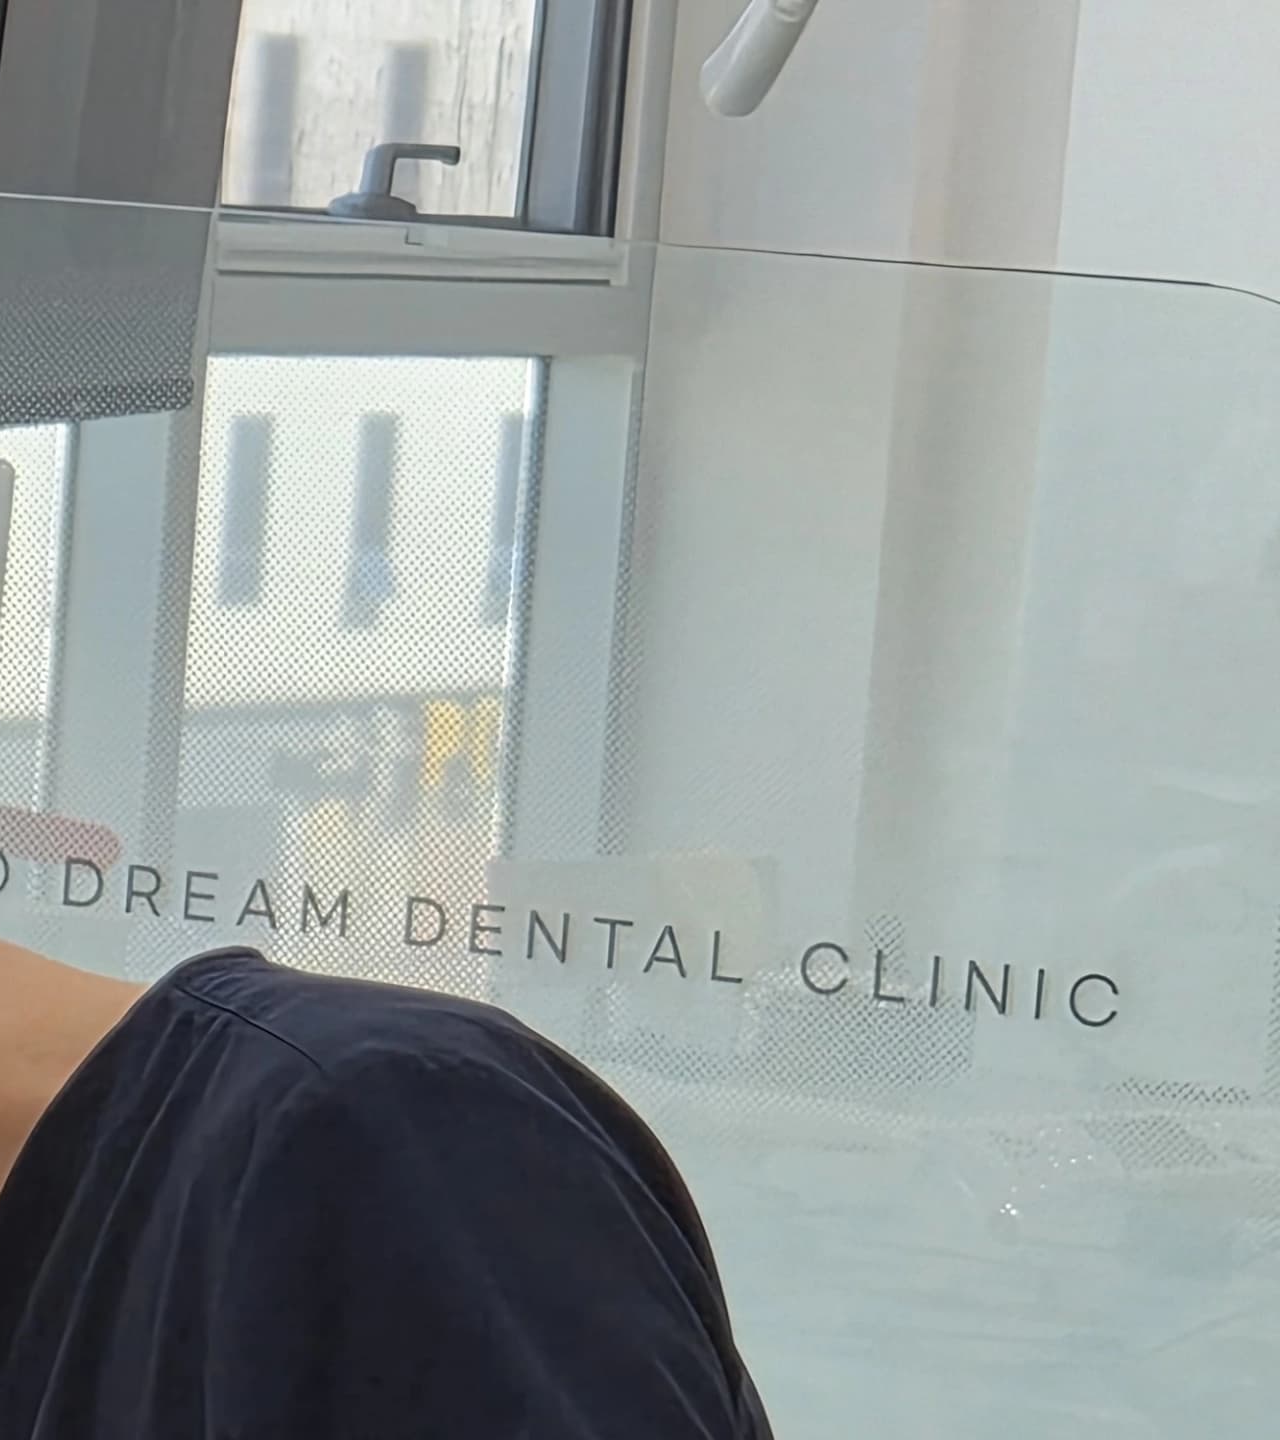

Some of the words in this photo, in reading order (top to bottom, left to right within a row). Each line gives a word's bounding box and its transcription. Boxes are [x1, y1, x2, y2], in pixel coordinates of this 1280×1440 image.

[62, 857, 351, 937] DREAM
[403, 897, 743, 984] DENTAL
[800, 941, 1120, 1028] CLINIC
